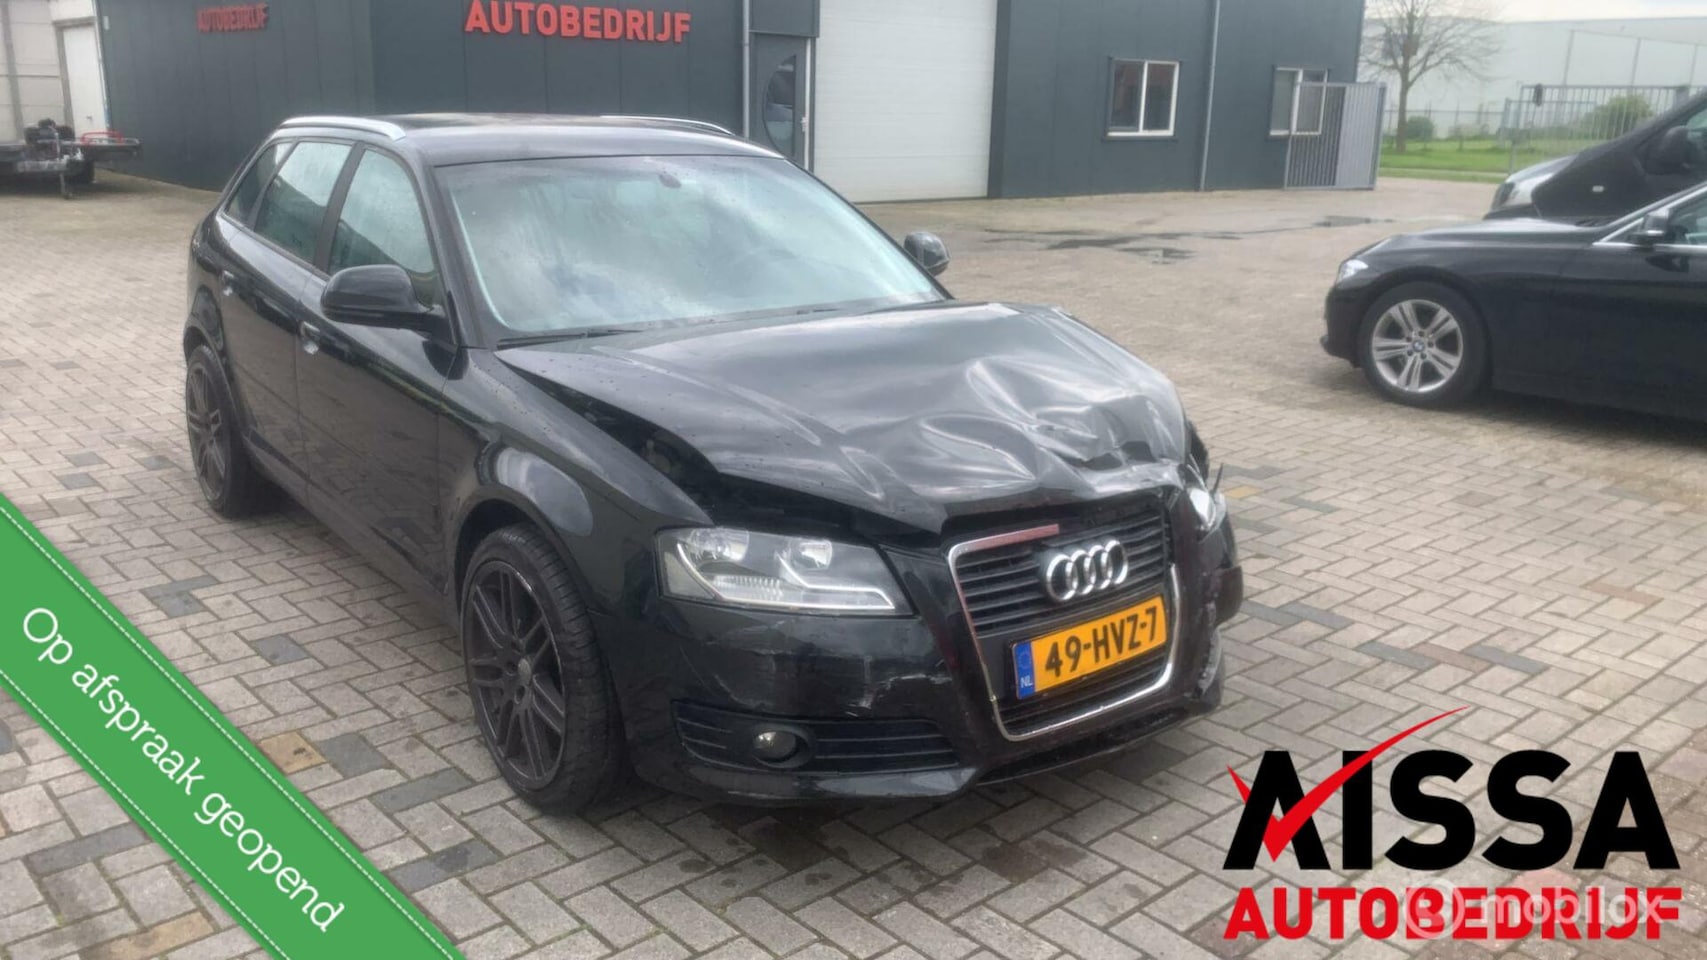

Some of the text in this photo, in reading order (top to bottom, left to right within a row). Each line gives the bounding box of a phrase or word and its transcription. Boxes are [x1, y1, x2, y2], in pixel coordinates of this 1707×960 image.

[197, 4, 268, 31] AUTOBEDRIJF
[464, 0, 691, 43] AUTOBEDRIJF
[1045, 606, 1158, 678] 49-HVZ-7
[1021, 678, 1034, 688] NL
